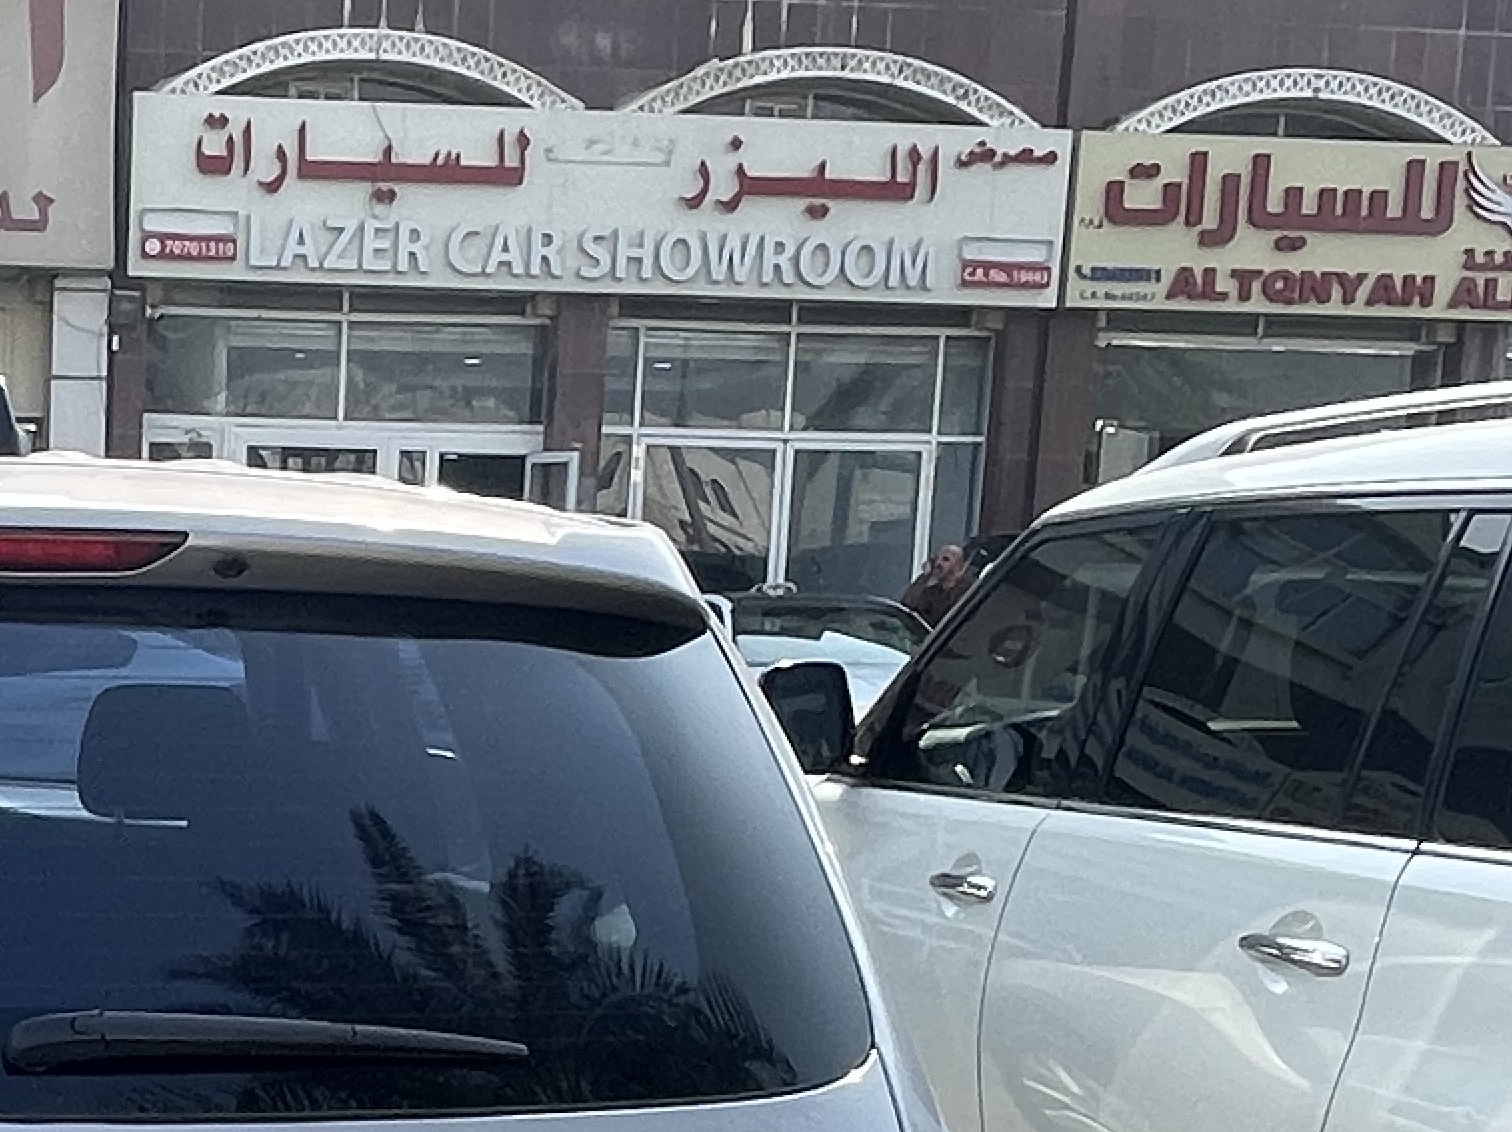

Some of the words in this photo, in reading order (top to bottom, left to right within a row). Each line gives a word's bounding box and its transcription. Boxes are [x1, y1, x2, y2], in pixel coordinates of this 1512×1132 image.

[195, 111, 531, 205] للسيارات
[680, 135, 941, 221] الليزر
[1103, 151, 1461, 252] للسيارات
[244, 213, 432, 276] LAZER
[447, 222, 564, 279] CAR
[577, 226, 938, 291] SHOWROOM
[1164, 266, 1437, 308] ALTQNYAH
